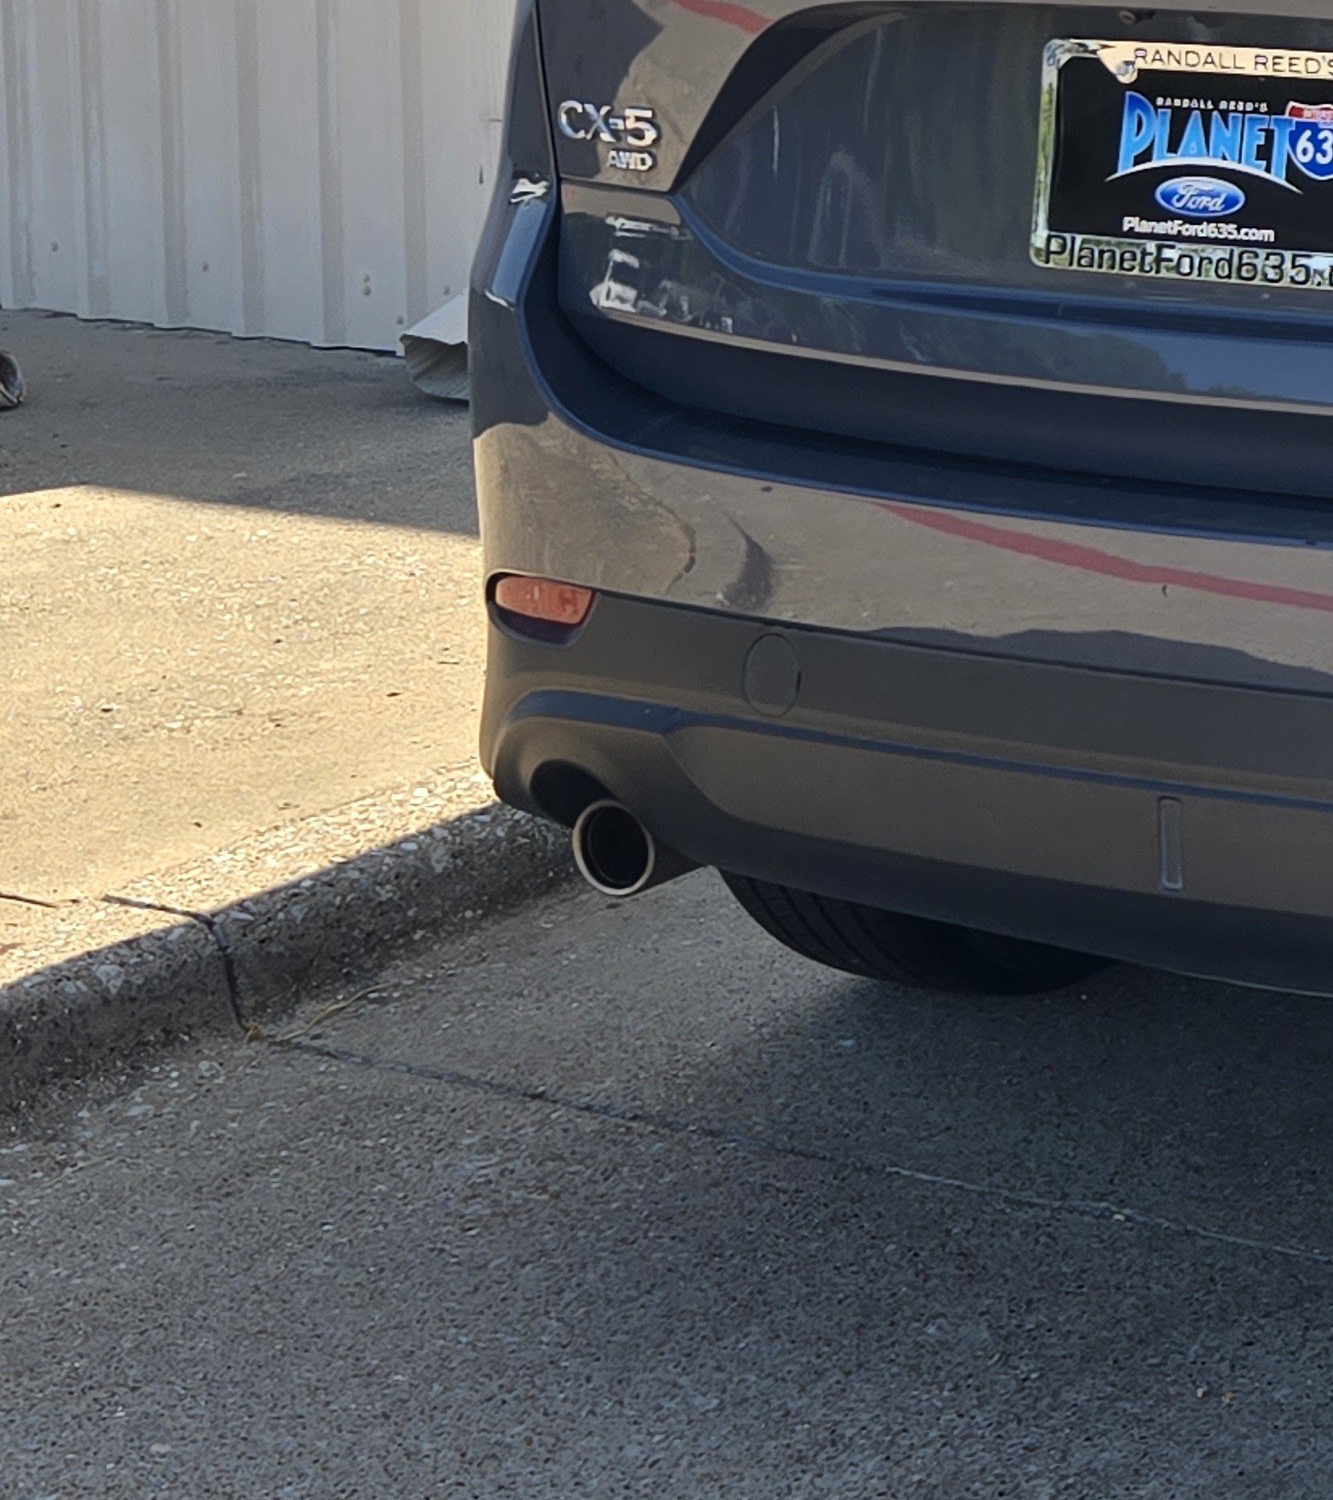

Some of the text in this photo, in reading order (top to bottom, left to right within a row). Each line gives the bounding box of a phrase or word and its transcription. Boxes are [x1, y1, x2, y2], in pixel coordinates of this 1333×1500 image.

[1134, 47, 1245, 70] RANDALL
[557, 99, 658, 147] CX-5
[1117, 90, 1296, 181] PLANET
[608, 149, 653, 172] AWD
[1170, 182, 1228, 212] Ford
[1122, 216, 1275, 242] PlanetFord635.com
